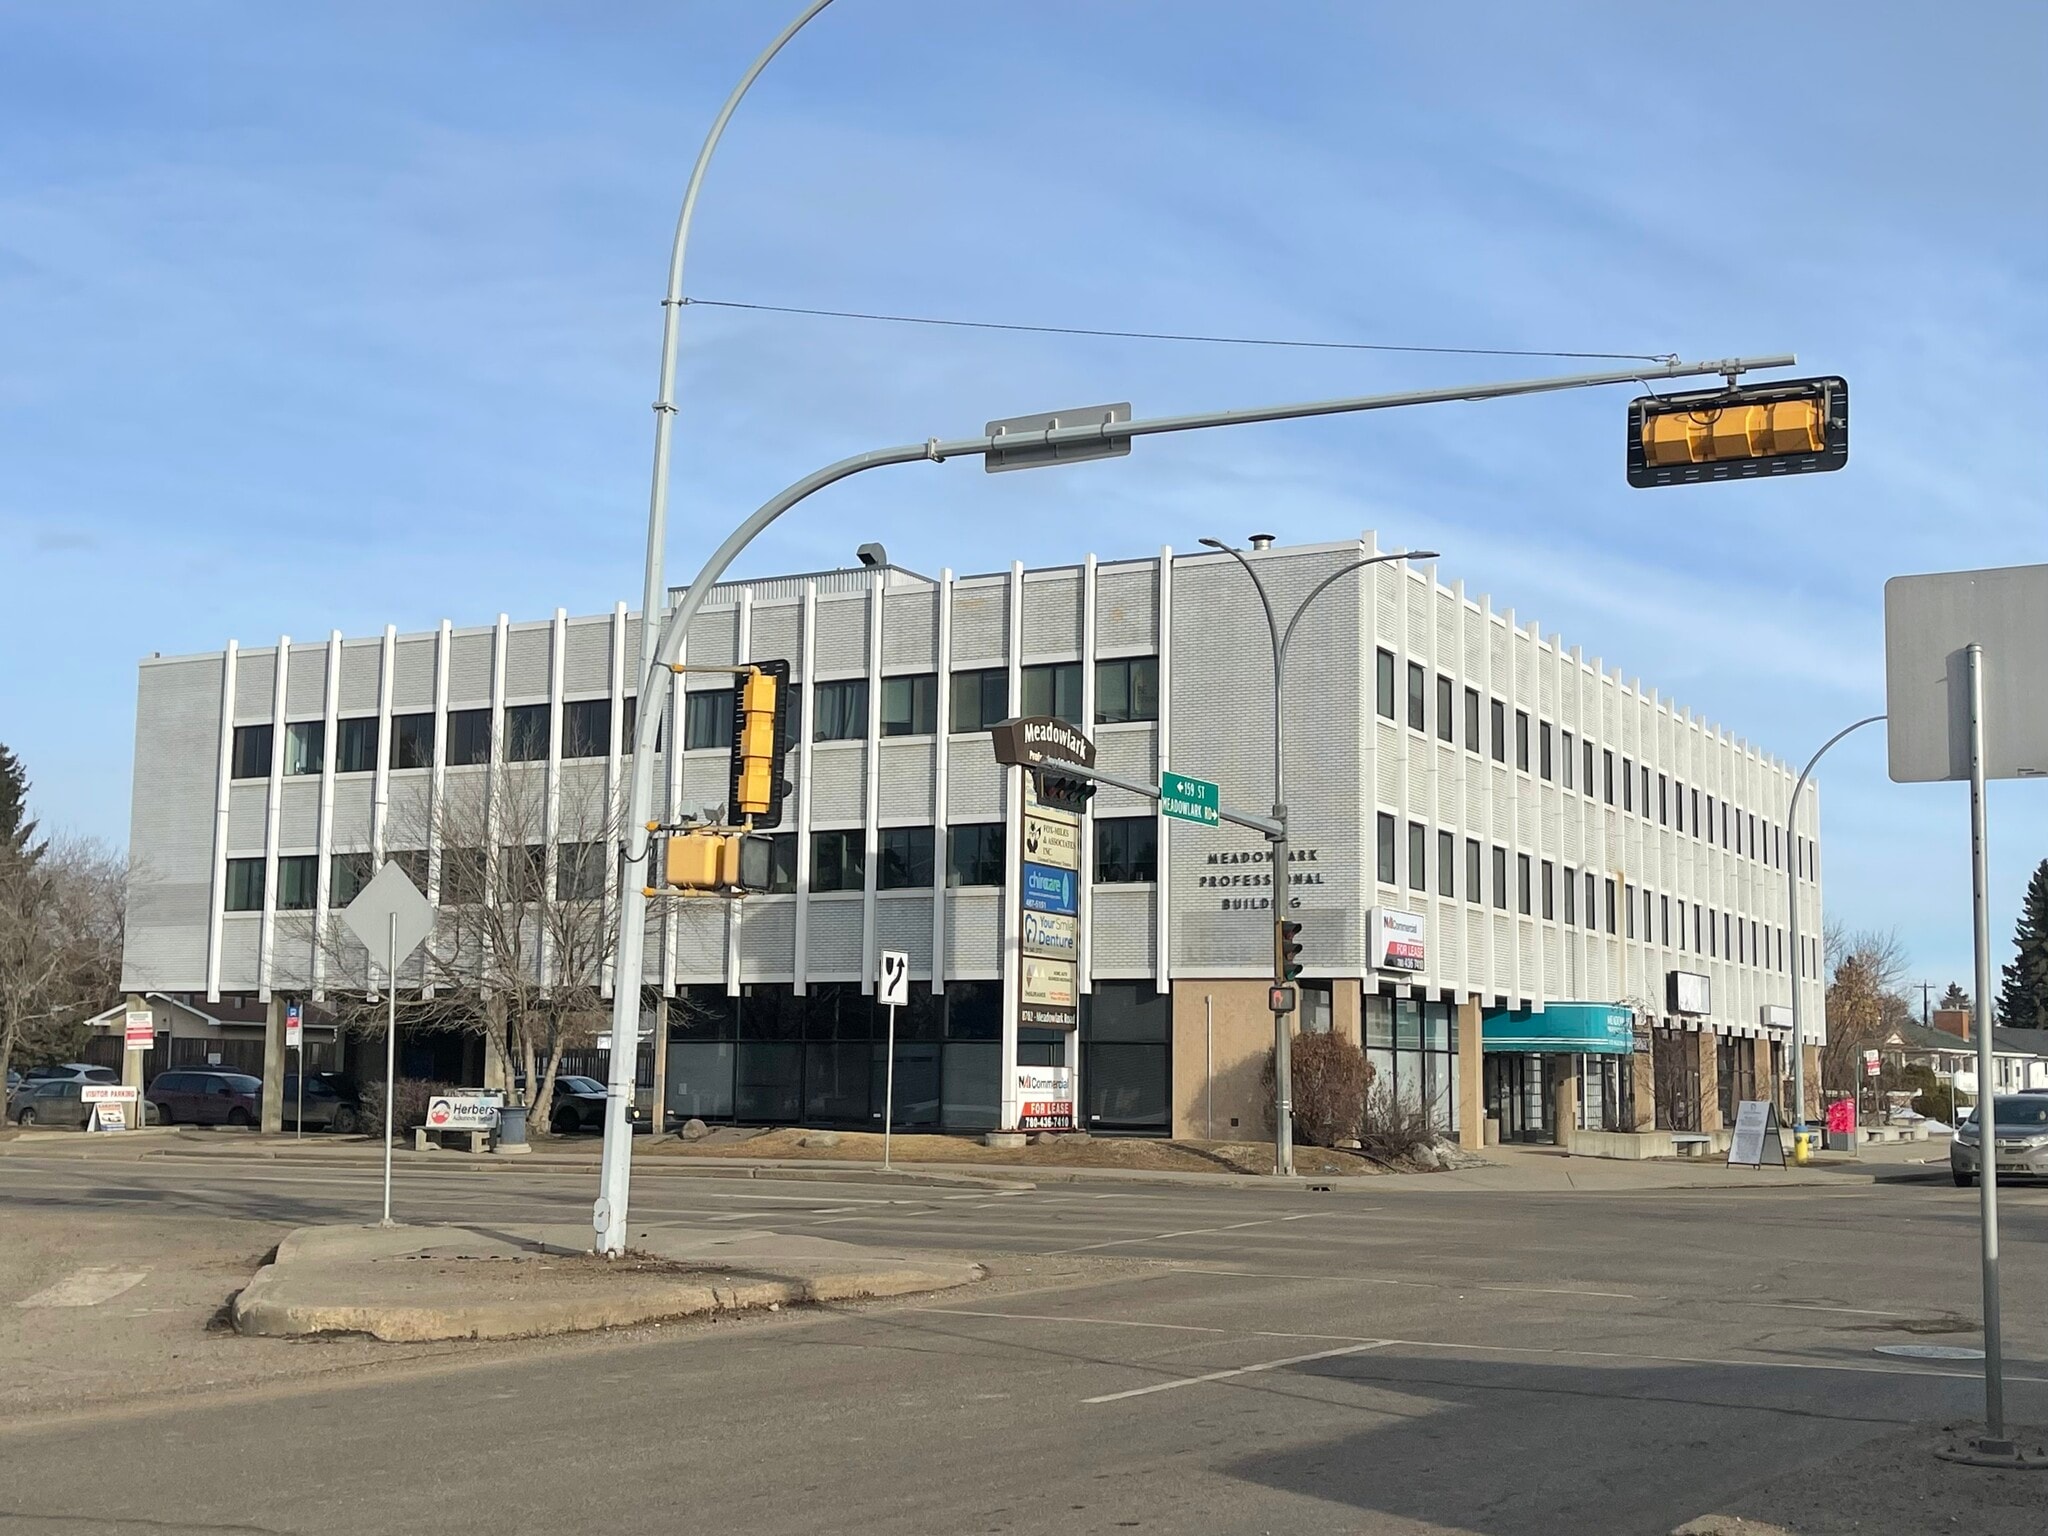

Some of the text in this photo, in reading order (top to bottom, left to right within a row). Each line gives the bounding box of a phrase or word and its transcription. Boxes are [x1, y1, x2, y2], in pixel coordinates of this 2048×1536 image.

[1024, 722, 1087, 760] Meadowlark
[1184, 781, 1205, 799] 159 ST
[1162, 797, 1213, 820] MEADOWLARK RD
[1207, 850, 1318, 865] MEADOWARK
[1028, 871, 1061, 892] chirocare
[1199, 873, 1324, 888] PROFESSNAL
[1040, 916, 1074, 932] Your Smile
[1038, 930, 1074, 949] Denture
[1396, 943, 1424, 958] FOR LEASE
[1036, 1012, 1064, 1023] Meadowlark
[1032, 1077, 1069, 1089] Commercial
[85, 1090, 135, 1098] VISITOR PARKING
[453, 1104, 495, 1115] Herbers
[1030, 1103, 1069, 1114] FOR LEASE
